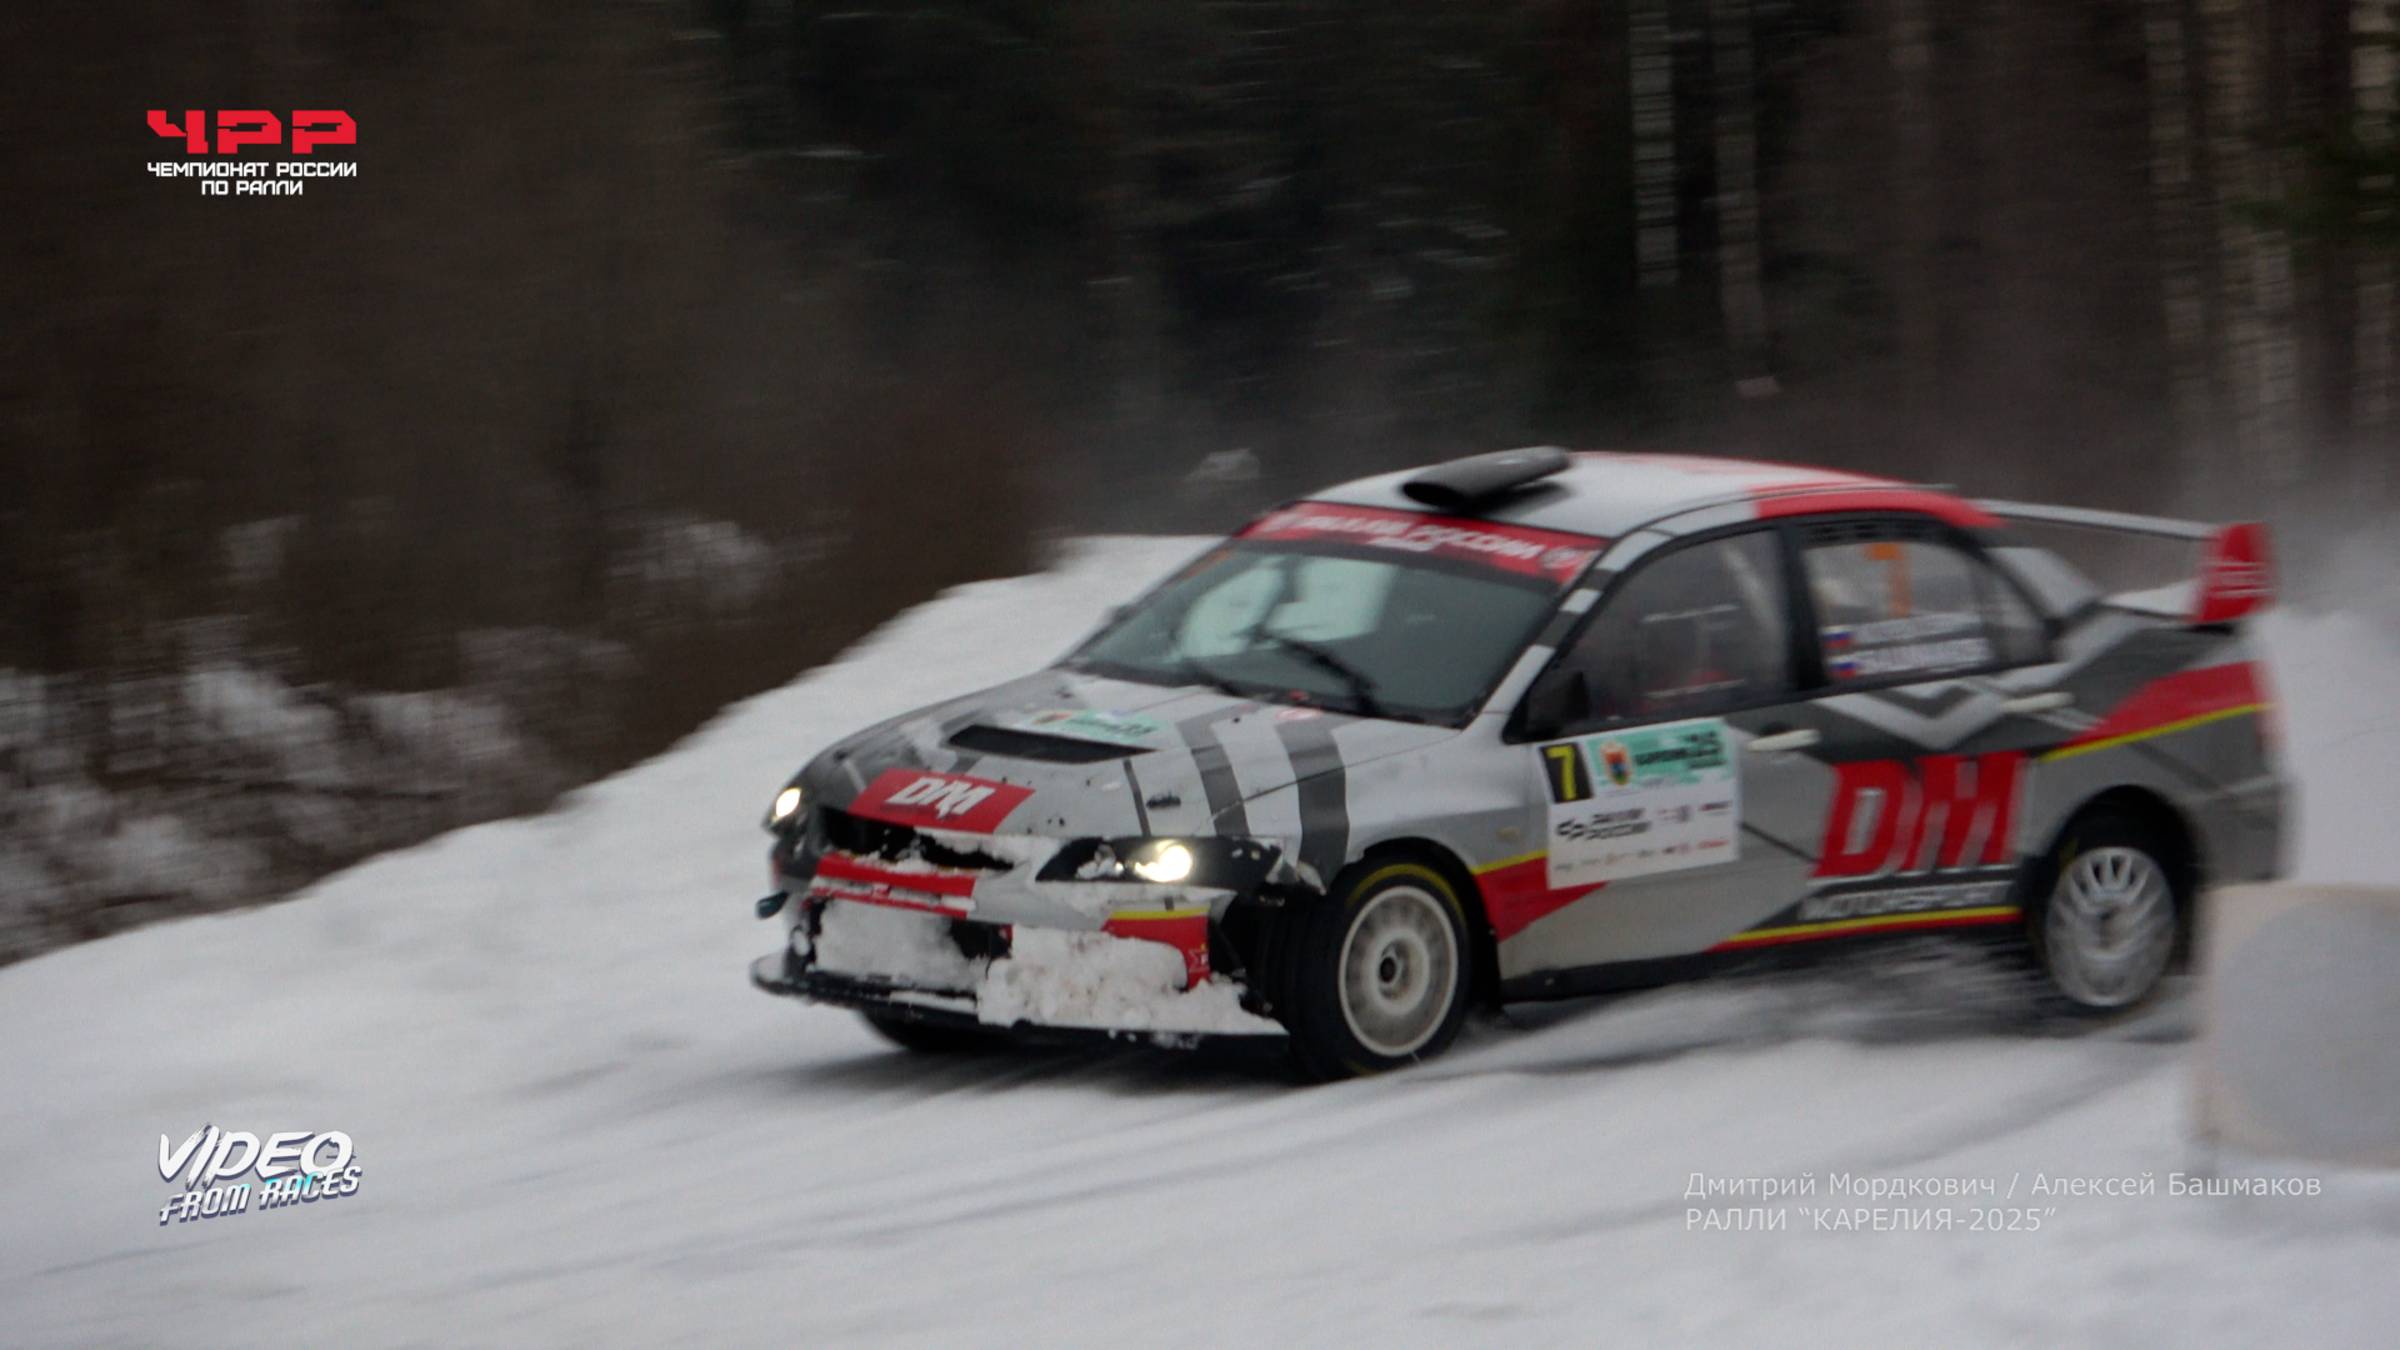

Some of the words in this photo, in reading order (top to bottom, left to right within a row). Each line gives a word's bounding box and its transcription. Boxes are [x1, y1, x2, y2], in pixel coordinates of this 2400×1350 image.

[884, 776, 997, 820] DM
[1546, 745, 1576, 800] 7
[1808, 750, 2026, 878] DM
